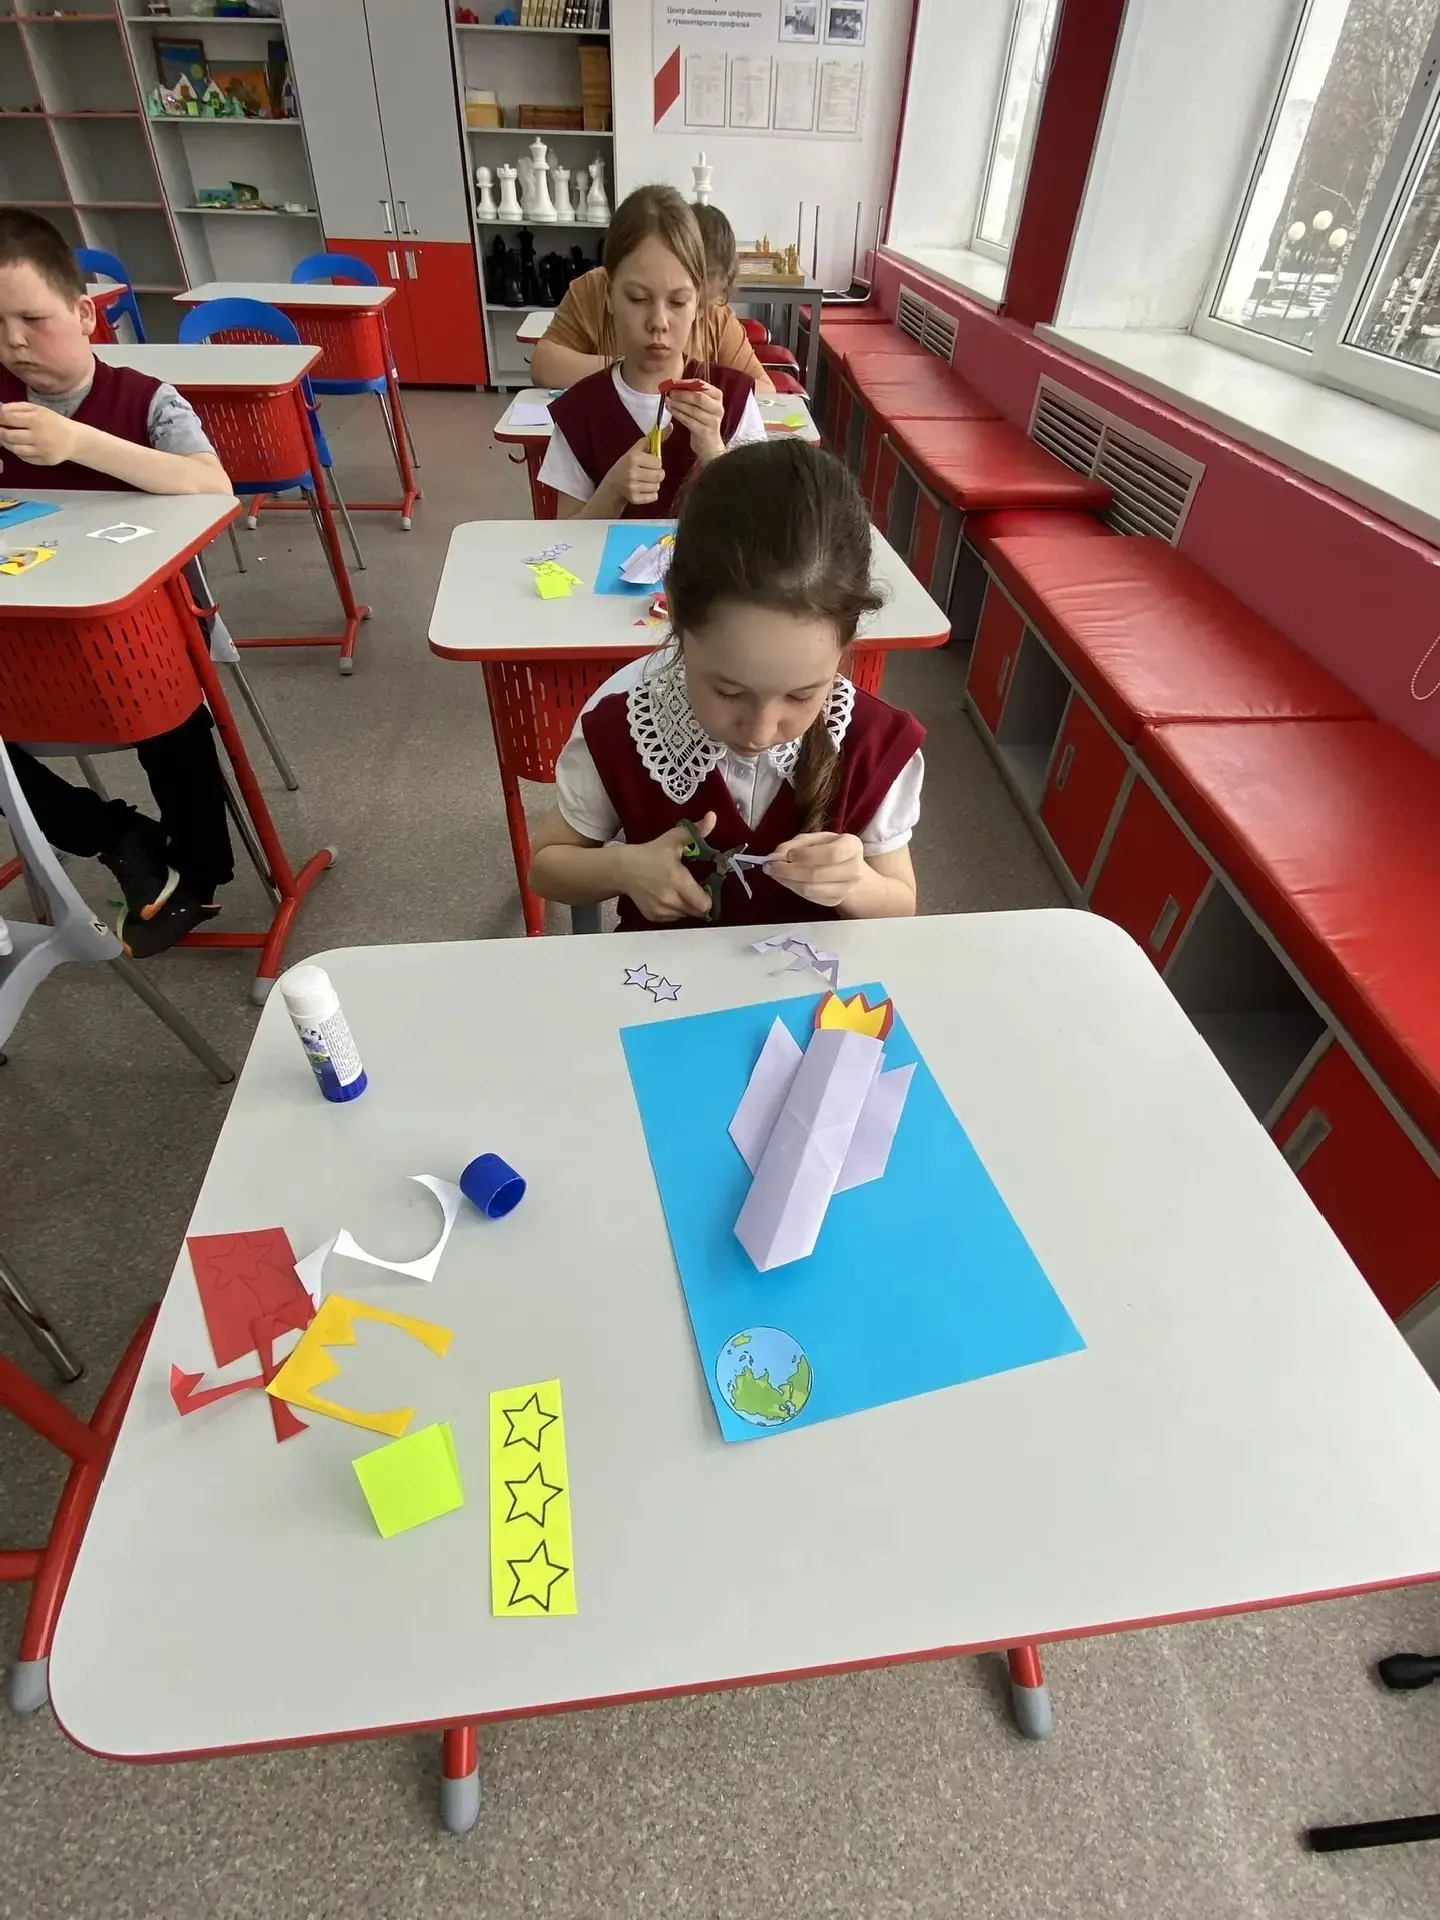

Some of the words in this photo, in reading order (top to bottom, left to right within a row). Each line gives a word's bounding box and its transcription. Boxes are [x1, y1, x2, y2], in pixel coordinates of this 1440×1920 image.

[667, 6, 686, 15] Центр
[687, 8, 727, 16] образования
[728, 10, 762, 18] цифрового
[673, 19, 718, 27] гуманитарного
